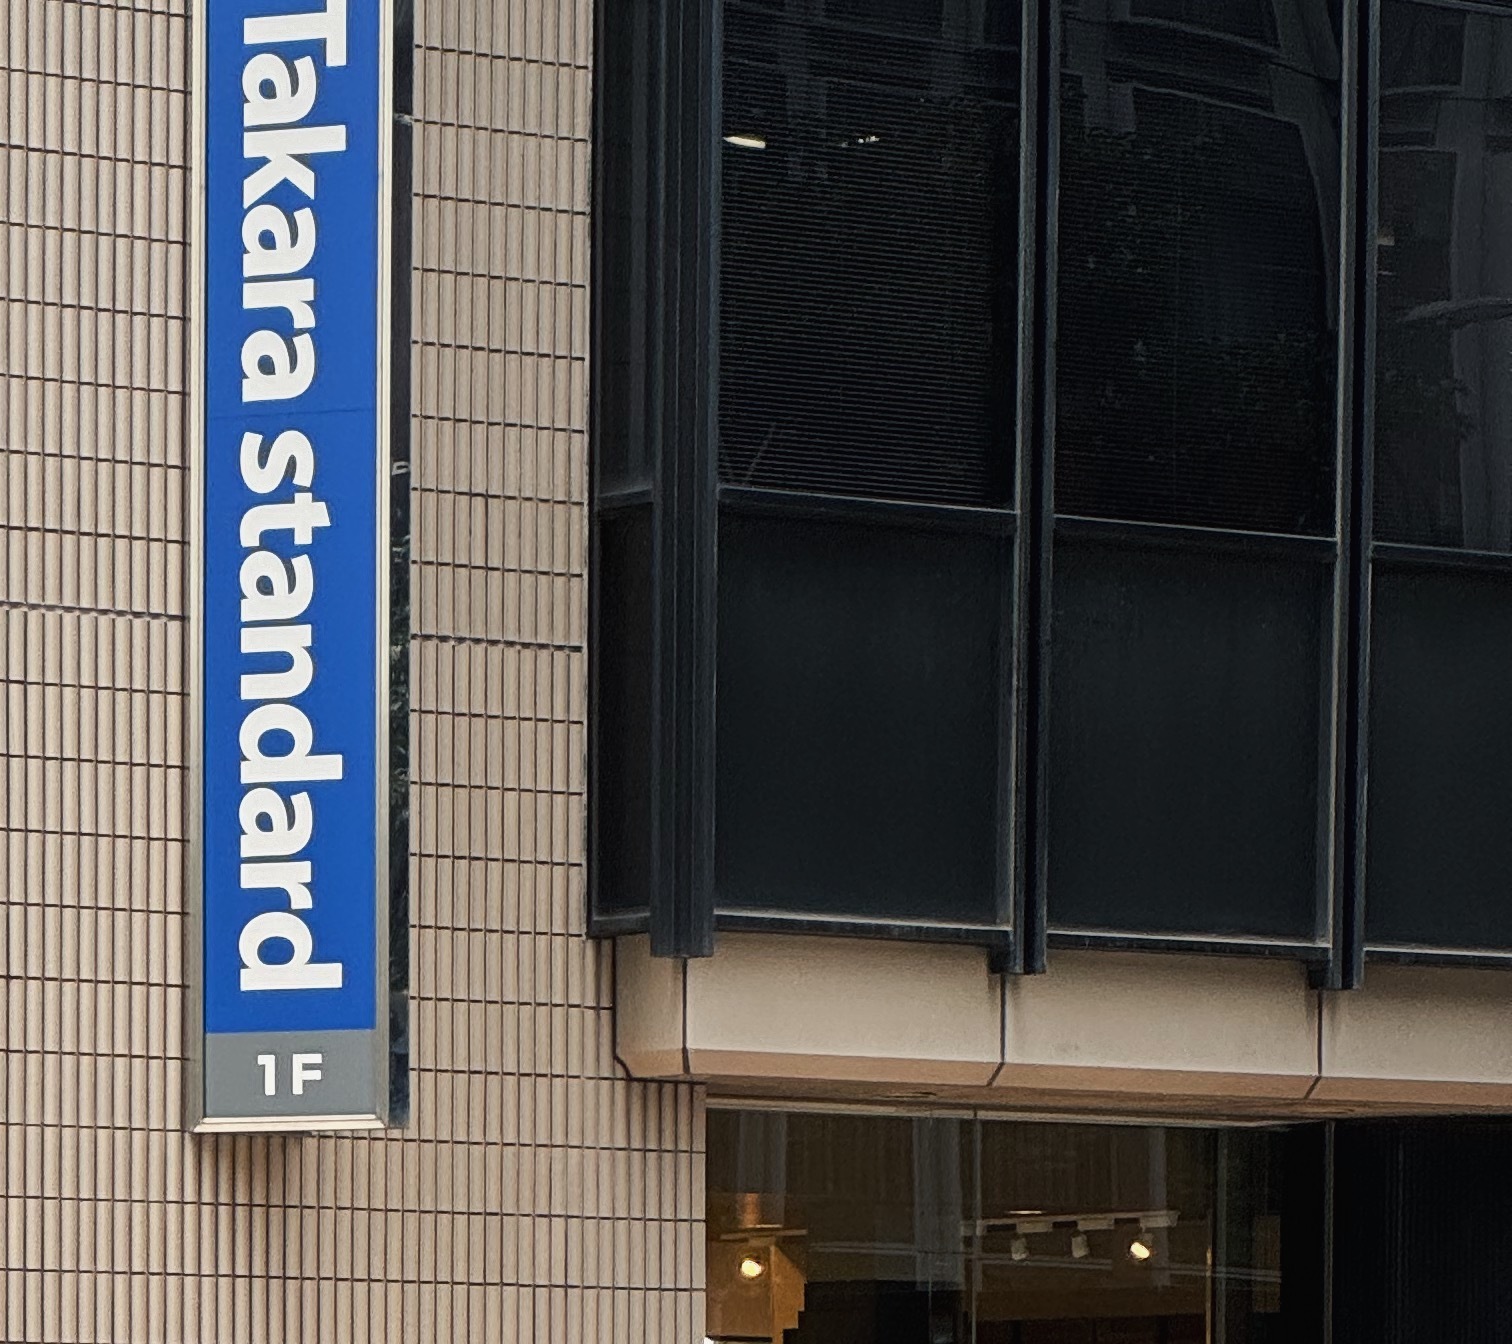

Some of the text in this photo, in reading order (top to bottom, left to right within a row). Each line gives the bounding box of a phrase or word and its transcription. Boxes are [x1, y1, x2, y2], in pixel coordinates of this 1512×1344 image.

[240, 0, 346, 991] Takara standard
[257, 1053, 323, 1096] 1F
